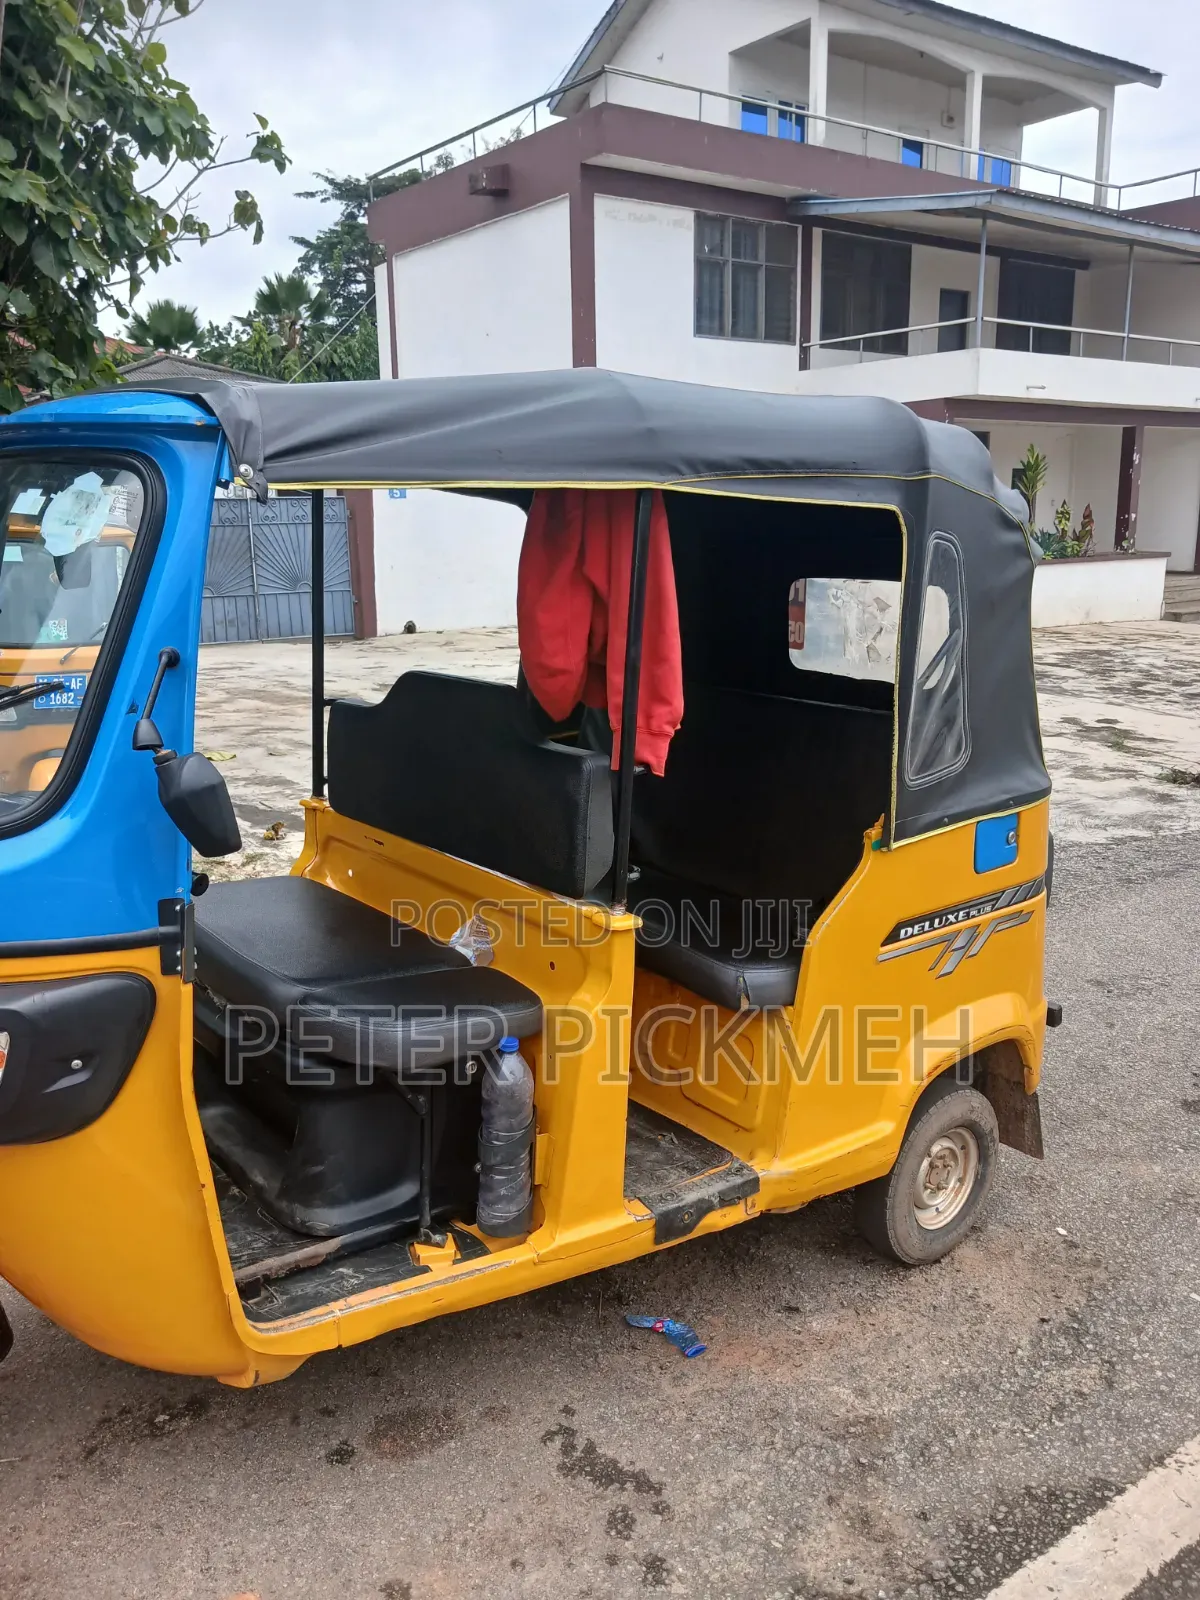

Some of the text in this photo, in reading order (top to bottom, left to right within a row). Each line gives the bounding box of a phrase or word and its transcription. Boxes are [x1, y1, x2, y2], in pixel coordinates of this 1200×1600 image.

[49, 692, 74, 705] 1682
[900, 904, 991, 939] DELUXE PLUS
